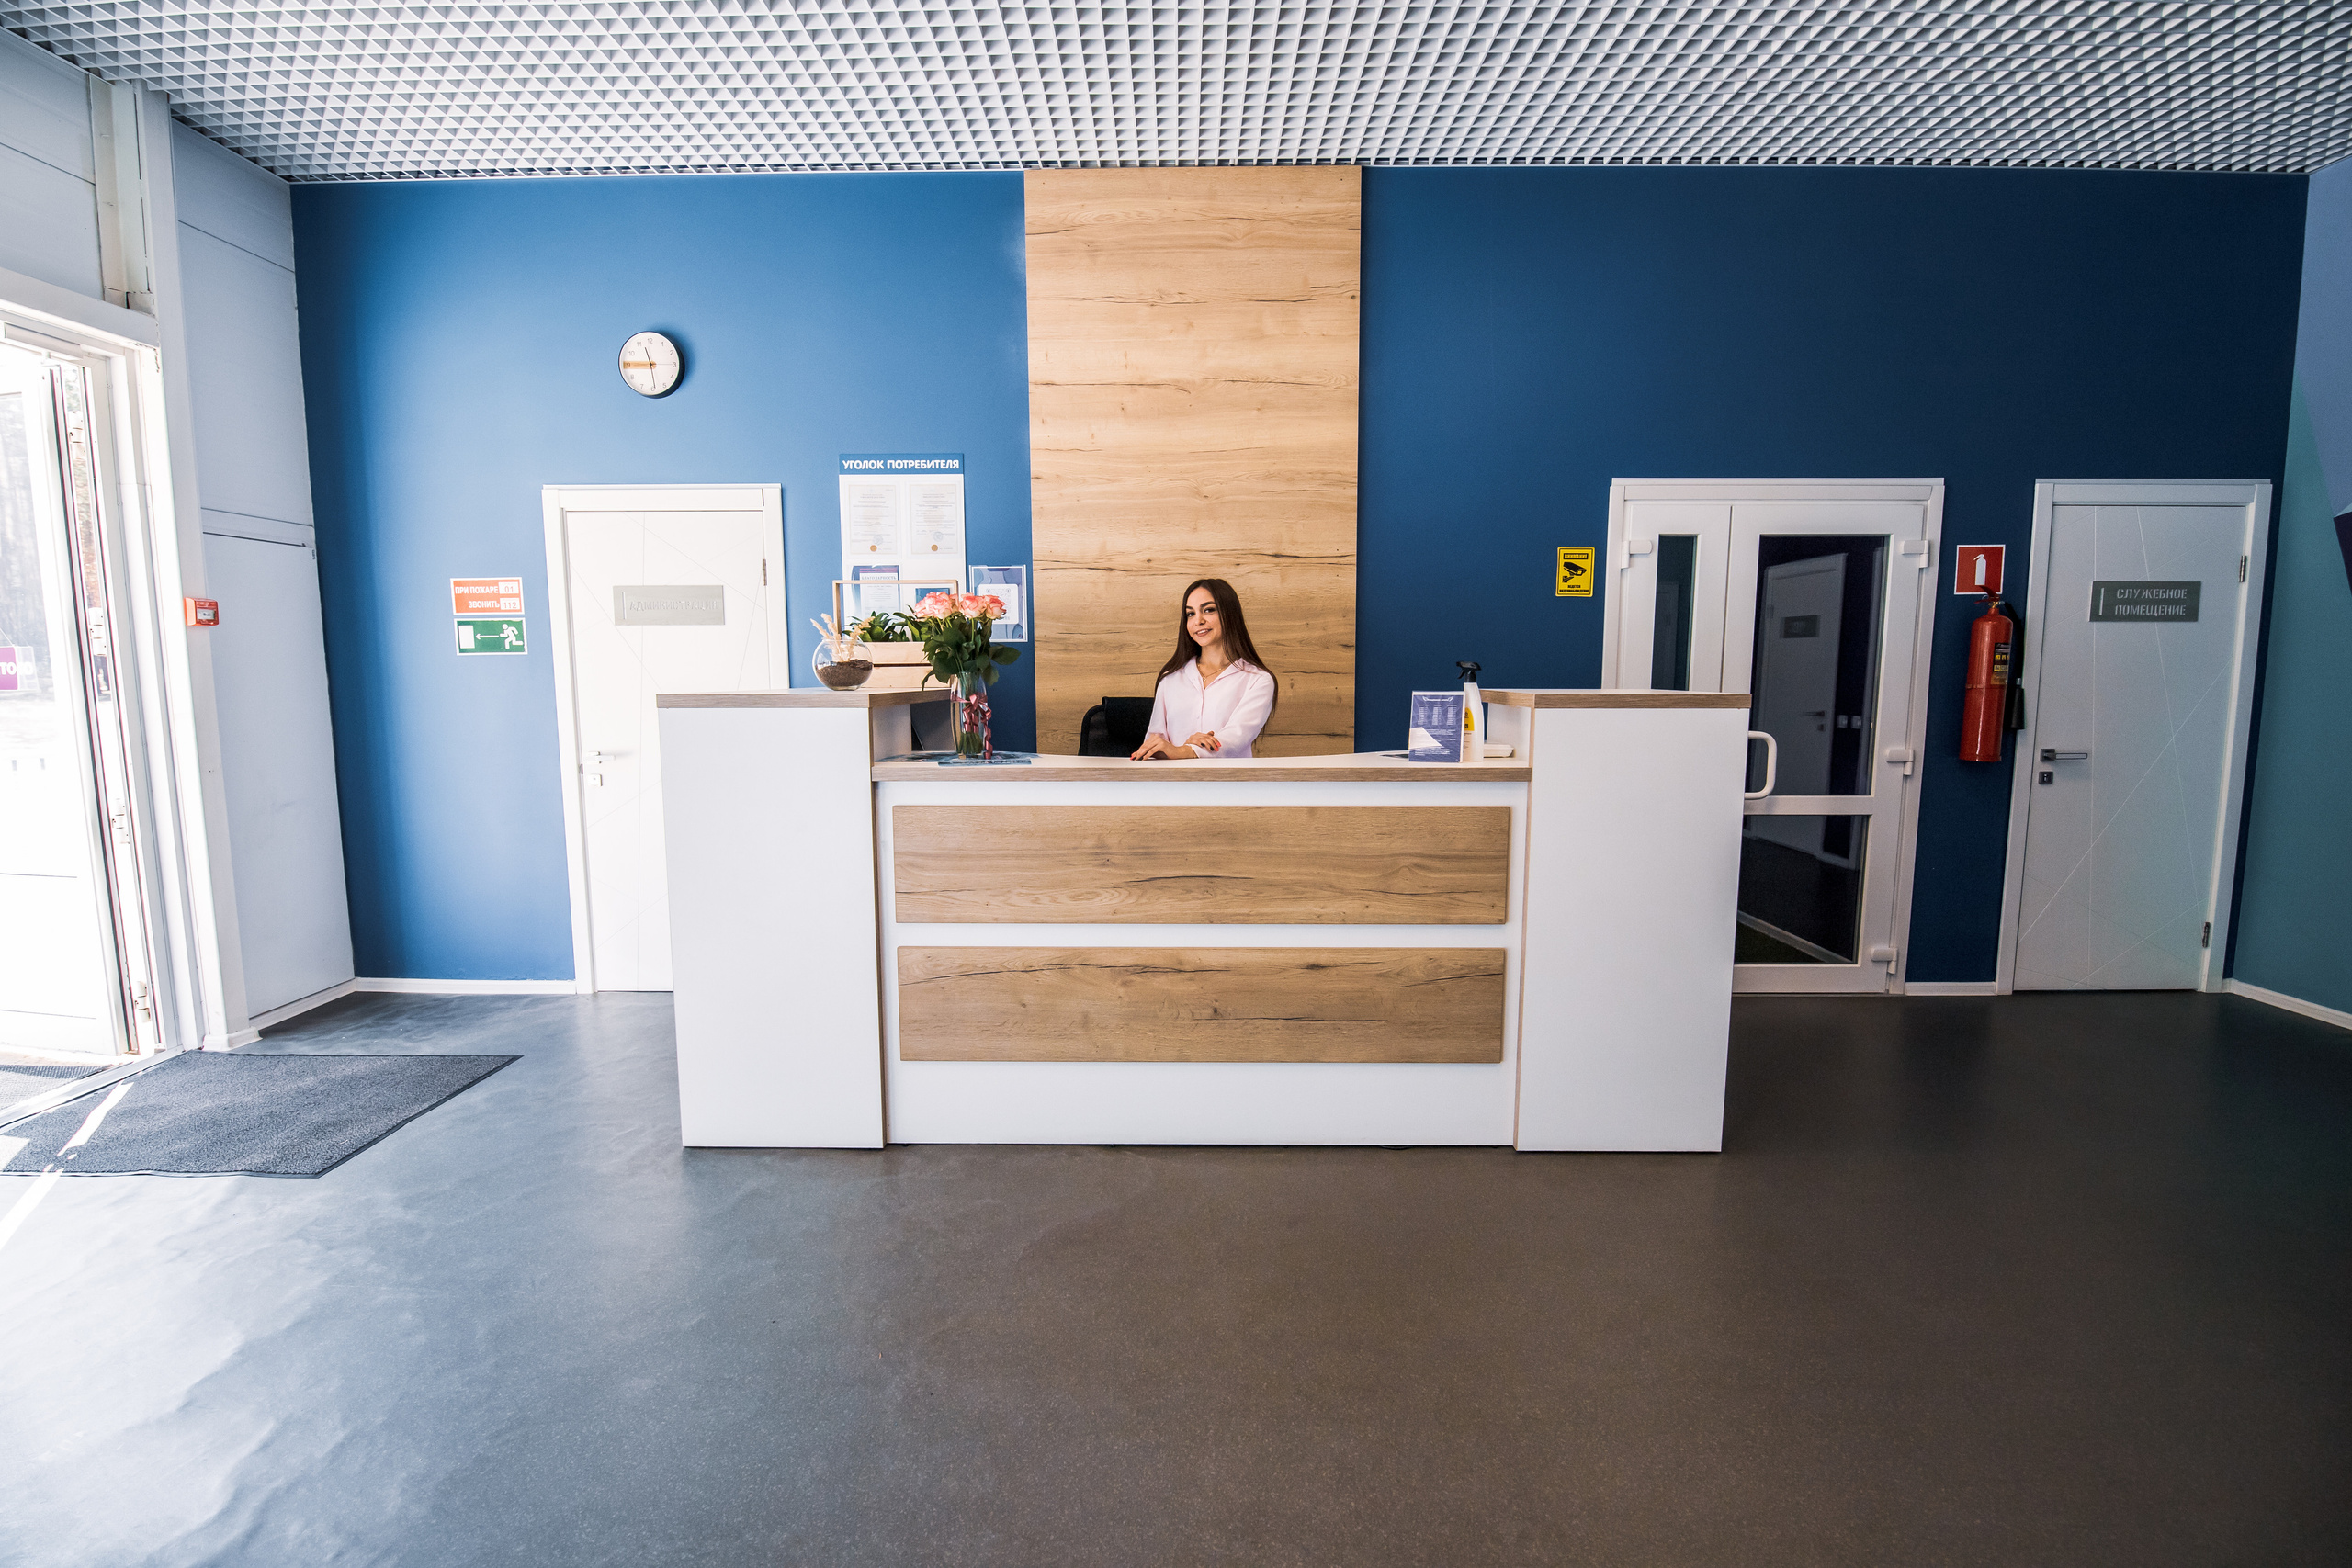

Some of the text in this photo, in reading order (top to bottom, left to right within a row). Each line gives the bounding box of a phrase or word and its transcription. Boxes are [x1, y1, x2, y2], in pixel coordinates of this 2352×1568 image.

[842, 459, 960, 470] УГОЛОК ПОТРЕБИТЕЛЯ
[454, 585, 514, 594] ПРИ ПОЖАРЕ 01
[2116, 588, 2188, 599] СЛУЖЕБНОЕ
[468, 600, 517, 609] ЗВОНИТЬ 112
[629, 600, 718, 612] АДМИНИСТРАЦИЯ
[2115, 604, 2187, 616] ПОМЕЩЕНИЕ
